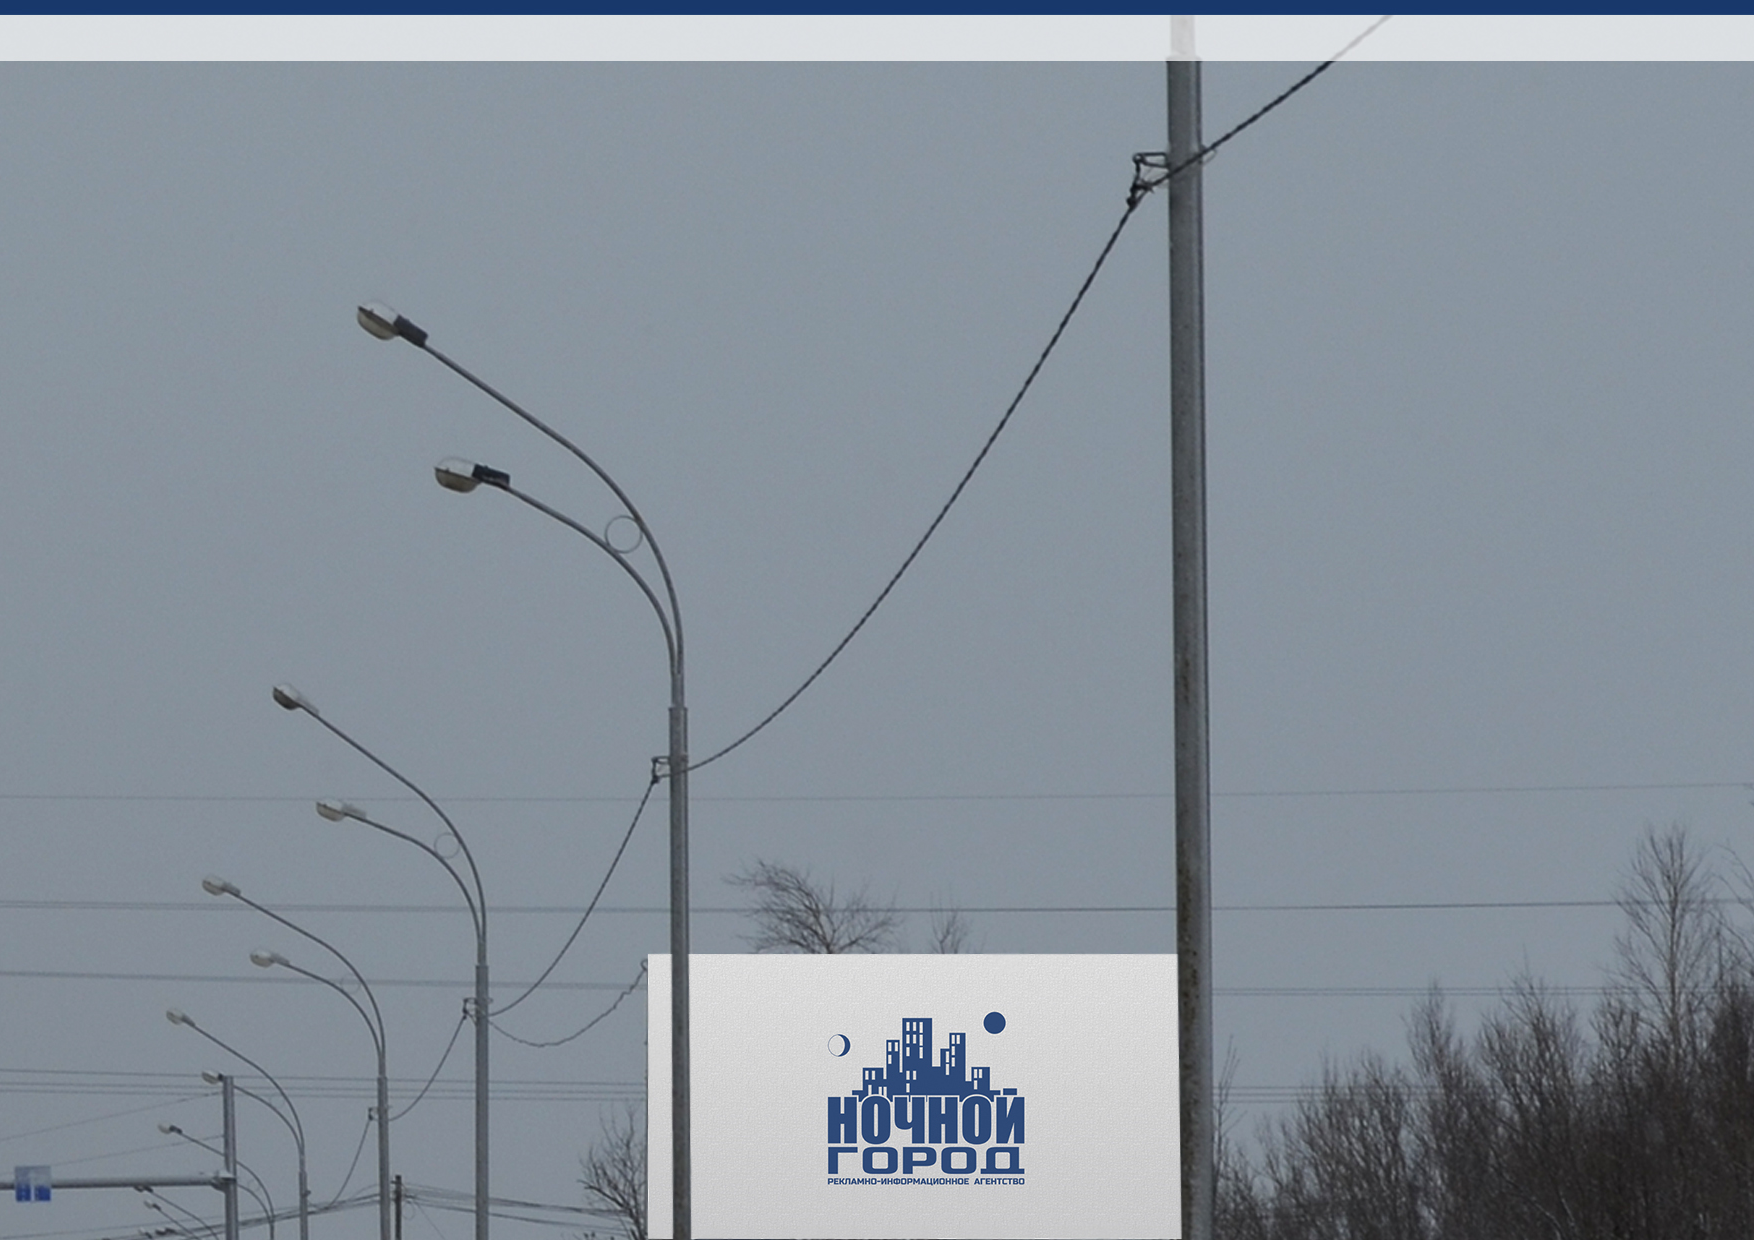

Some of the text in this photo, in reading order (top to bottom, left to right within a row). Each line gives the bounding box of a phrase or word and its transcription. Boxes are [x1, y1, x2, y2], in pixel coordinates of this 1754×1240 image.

[828, 1088, 1025, 1144] НОЧНОЙ
[828, 1147, 1025, 1174] ГОРОД
[828, 1177, 1025, 1186] РЕКЛАМНО-ИНФОРМАЦИОННОЕ АГЕНТСТВО
